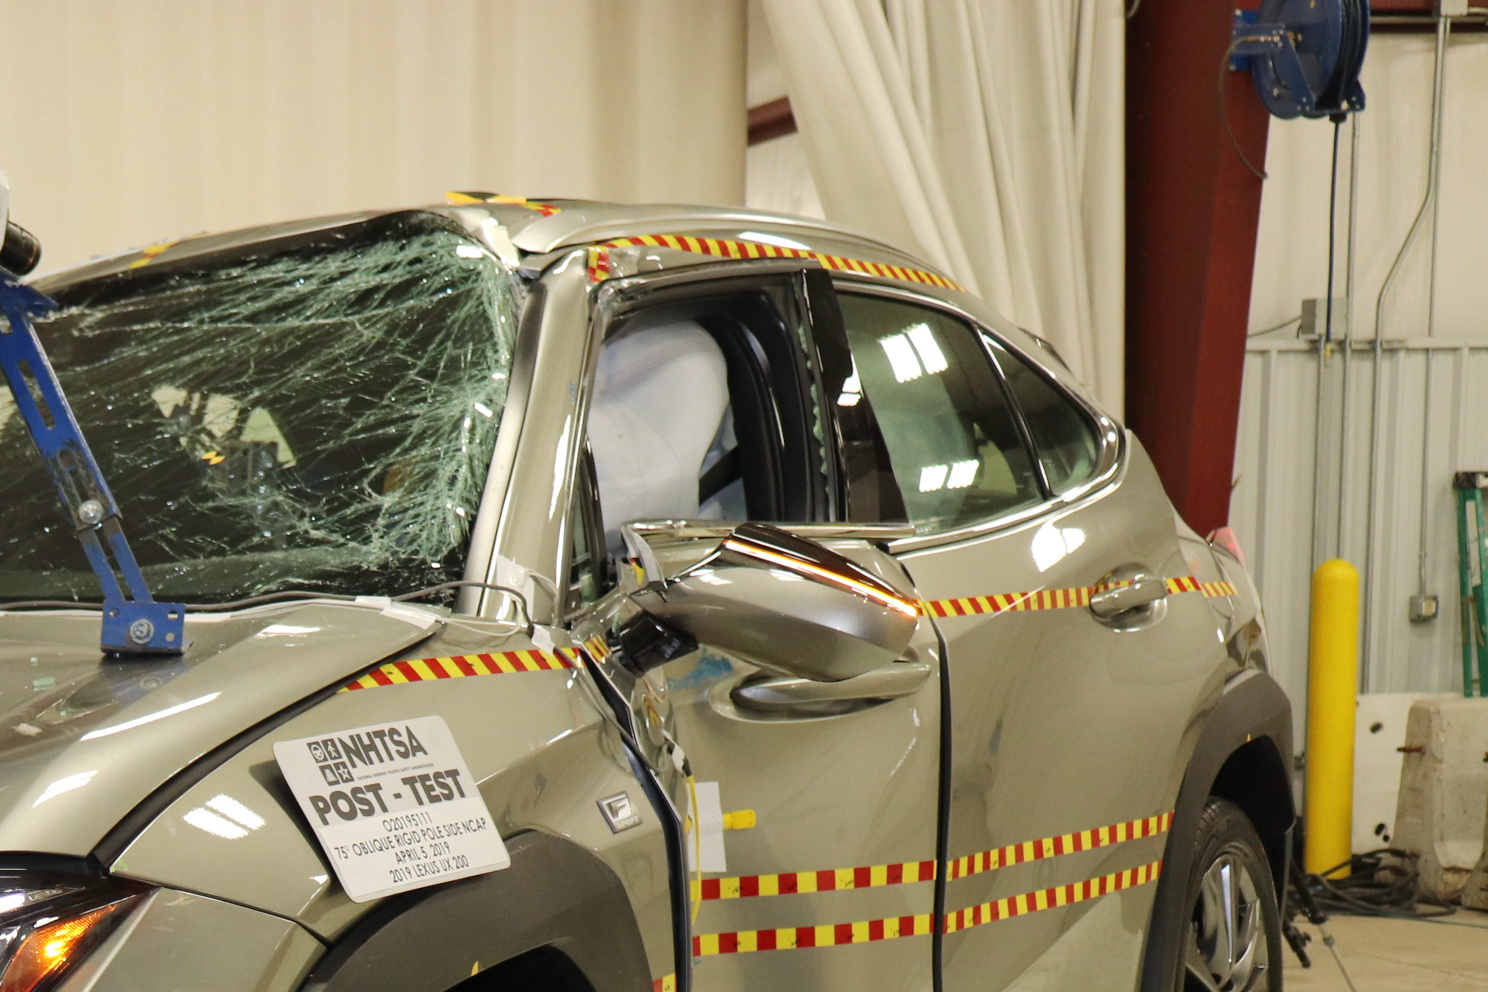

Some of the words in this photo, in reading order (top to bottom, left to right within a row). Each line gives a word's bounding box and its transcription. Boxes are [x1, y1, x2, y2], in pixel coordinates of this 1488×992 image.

[337, 725, 429, 769] NHTSA
[308, 782, 389, 826] POST
[400, 768, 466, 806] TEST
[352, 836, 396, 857] OBLIQUE
[395, 831, 422, 847] RIGID
[422, 825, 447, 842] POLE
[445, 822, 463, 838] SIDE
[462, 817, 487, 834] NCAP
[394, 849, 420, 865] APRIL
[421, 848, 432, 860] 5,
[429, 841, 452, 858] 2019
[389, 867, 414, 884] 2019
[413, 860, 441, 878] LEXUS
[440, 858, 454, 873] UX
[451, 854, 470, 870] 200
